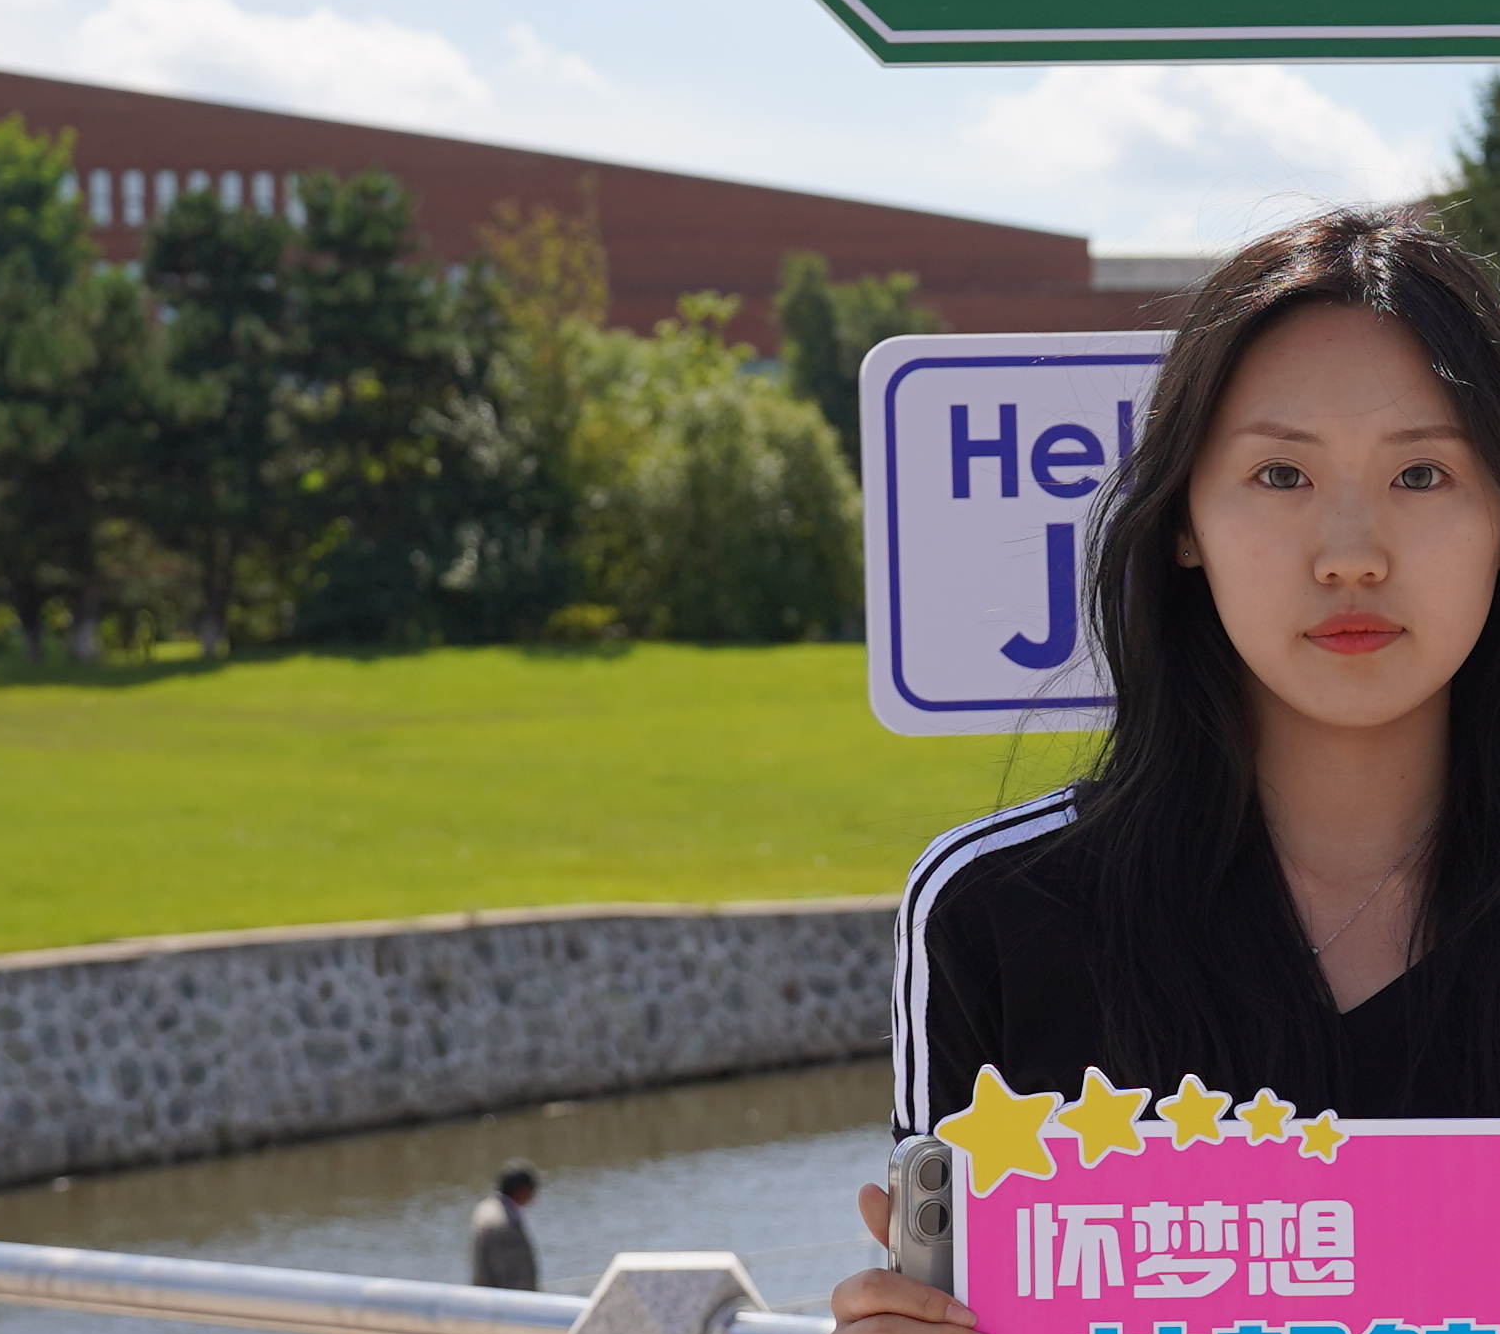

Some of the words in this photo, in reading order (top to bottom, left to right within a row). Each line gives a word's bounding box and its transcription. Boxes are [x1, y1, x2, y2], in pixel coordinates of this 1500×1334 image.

[950, 400, 1138, 499] Hel
[1000, 522, 1085, 669] J
[1015, 1198, 1356, 1301] 怀梦想
